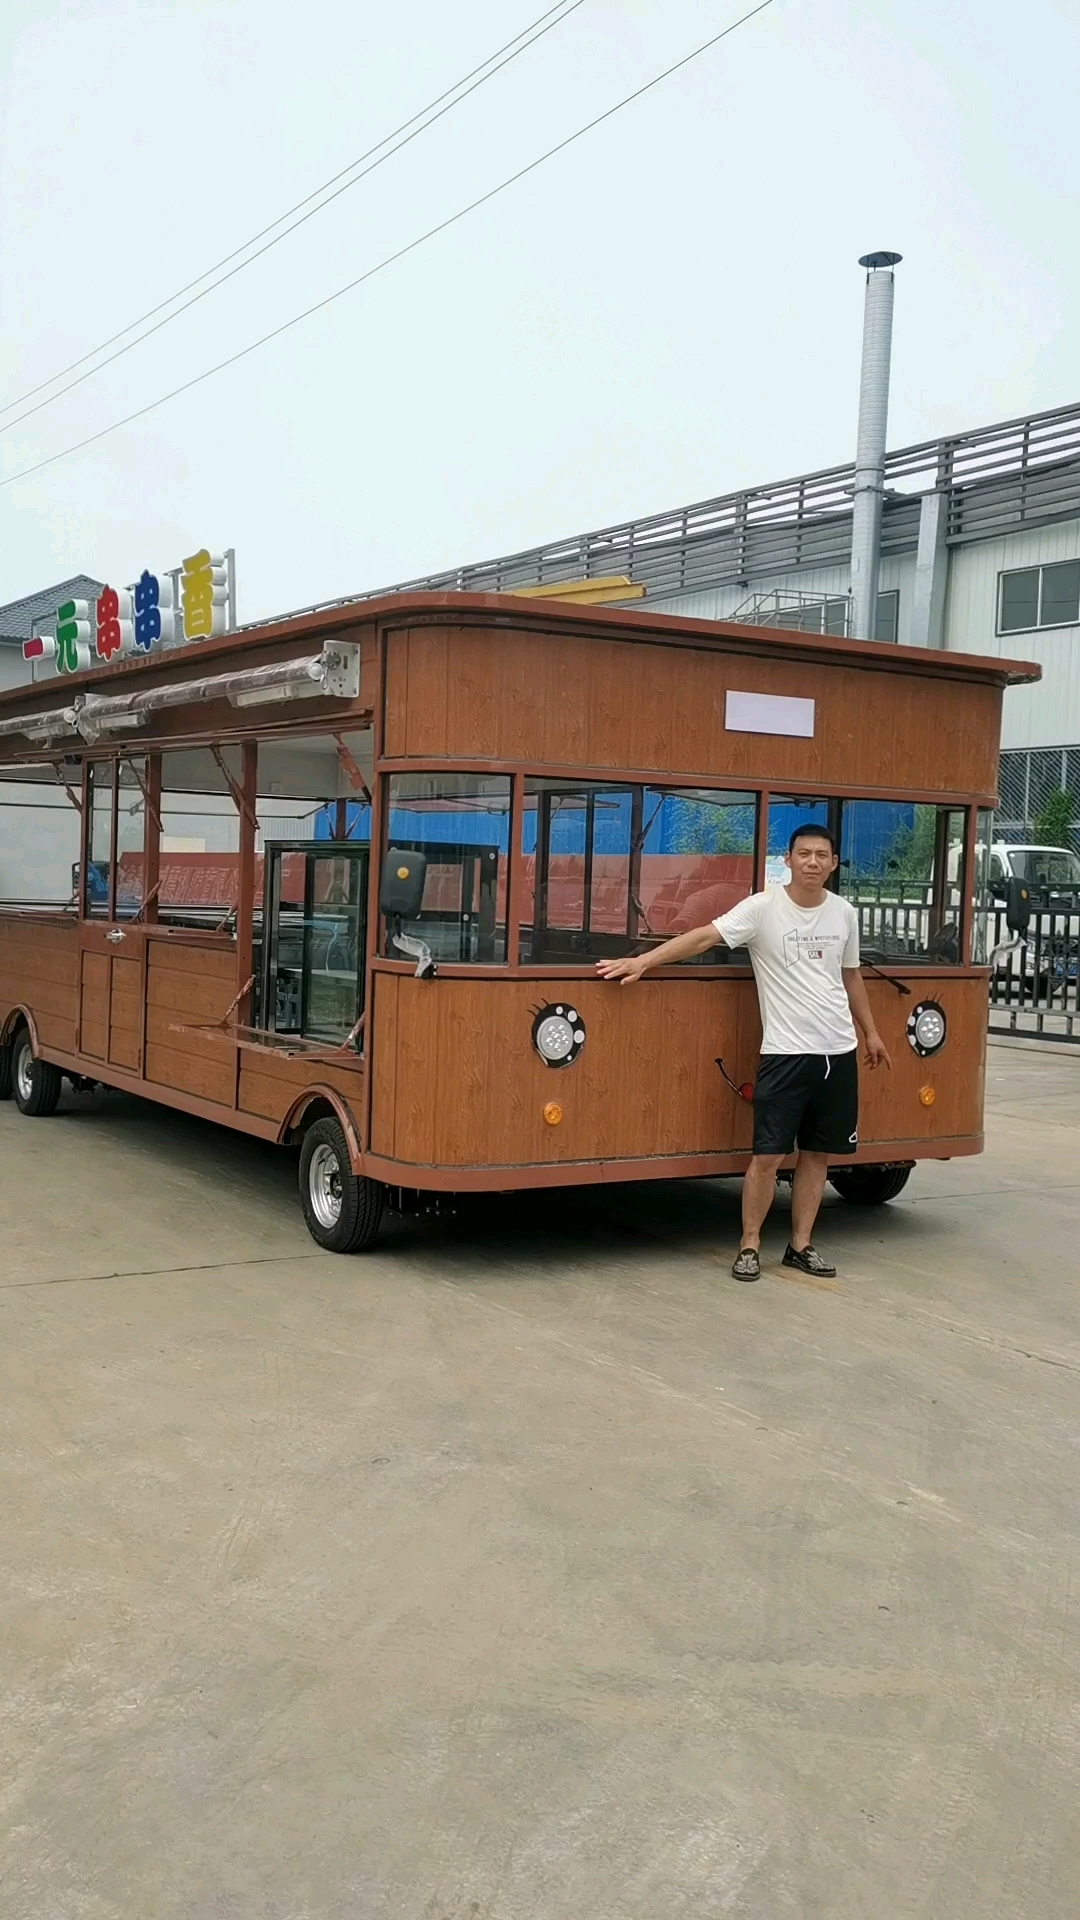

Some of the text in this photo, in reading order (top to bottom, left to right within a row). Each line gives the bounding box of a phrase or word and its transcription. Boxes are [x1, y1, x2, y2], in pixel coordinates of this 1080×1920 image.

[23, 548, 214, 675] 一元串串香
